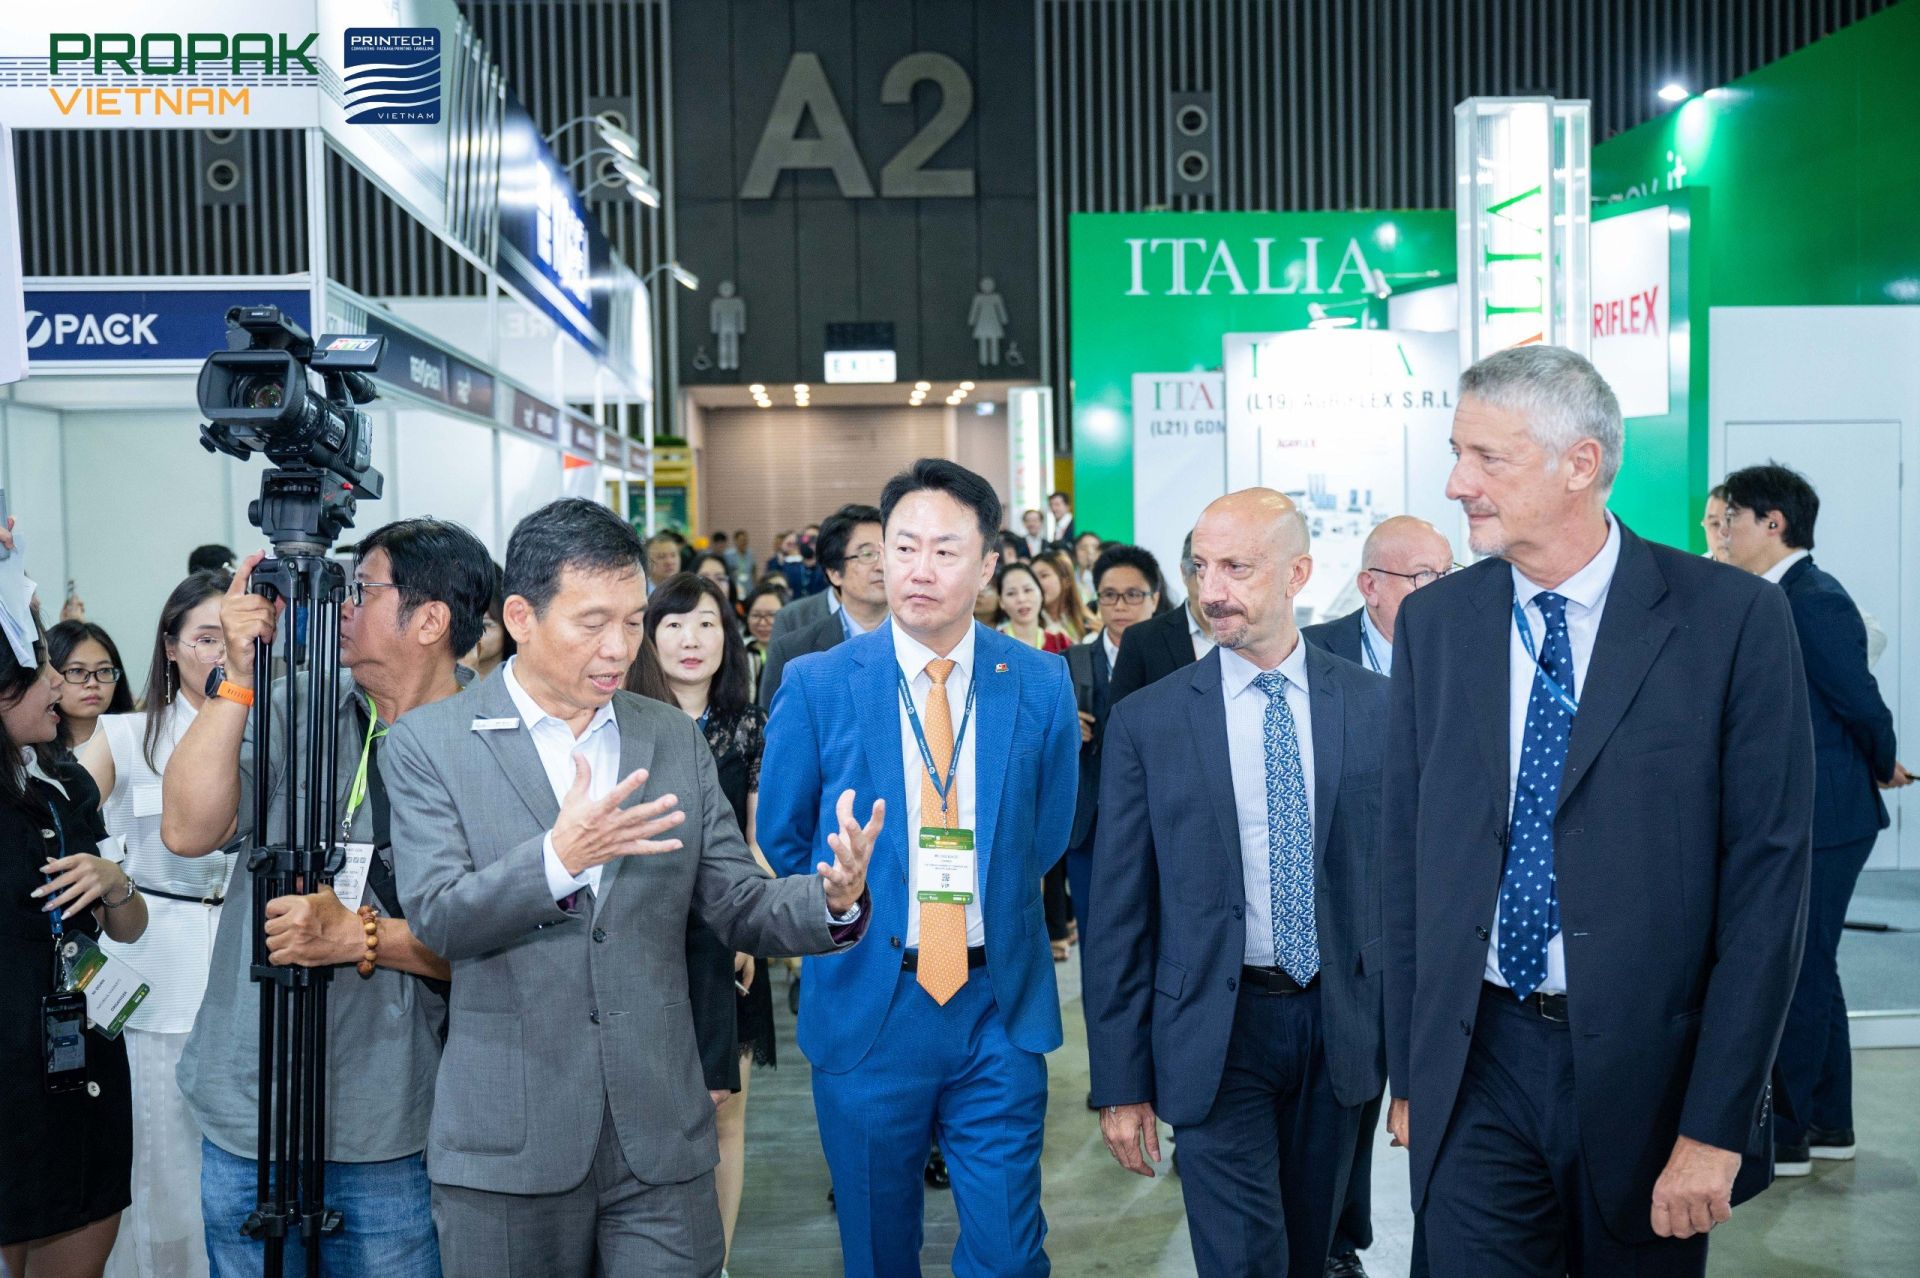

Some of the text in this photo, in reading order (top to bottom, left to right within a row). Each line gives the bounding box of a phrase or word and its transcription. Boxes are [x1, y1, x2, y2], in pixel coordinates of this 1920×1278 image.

[740, 52, 976, 198] A2
[1124, 237, 1378, 296] ITALIA
[55, 313, 159, 345] PACK
[1593, 285, 1660, 338] RIFLEX
